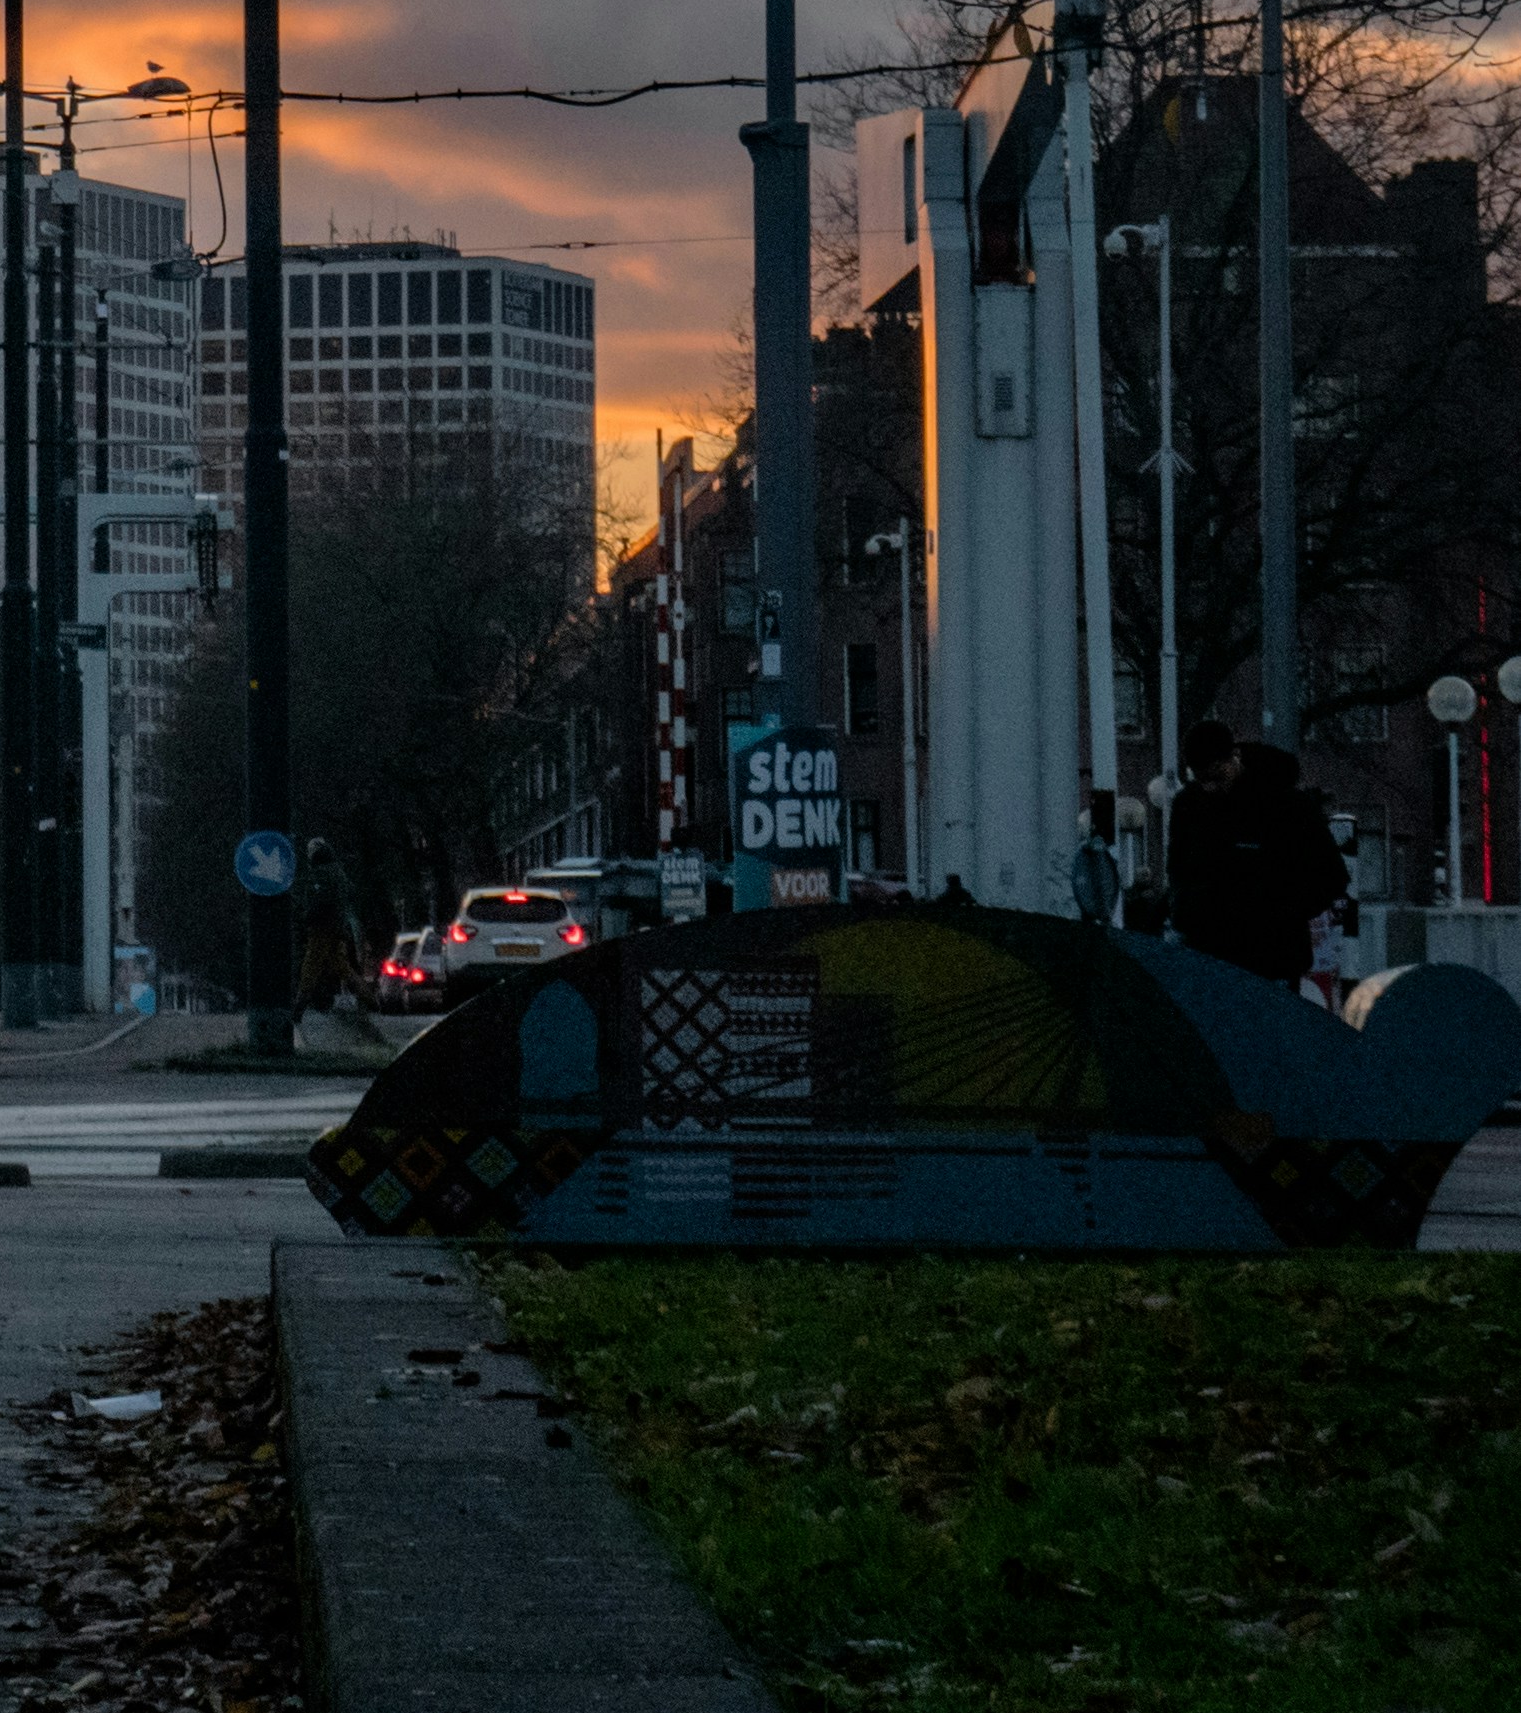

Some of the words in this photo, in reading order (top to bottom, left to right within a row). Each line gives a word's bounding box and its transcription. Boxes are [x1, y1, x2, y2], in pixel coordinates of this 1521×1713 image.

[748, 741, 838, 793] stem
[742, 798, 841, 849] DENK
[773, 871, 831, 899] VOOR
